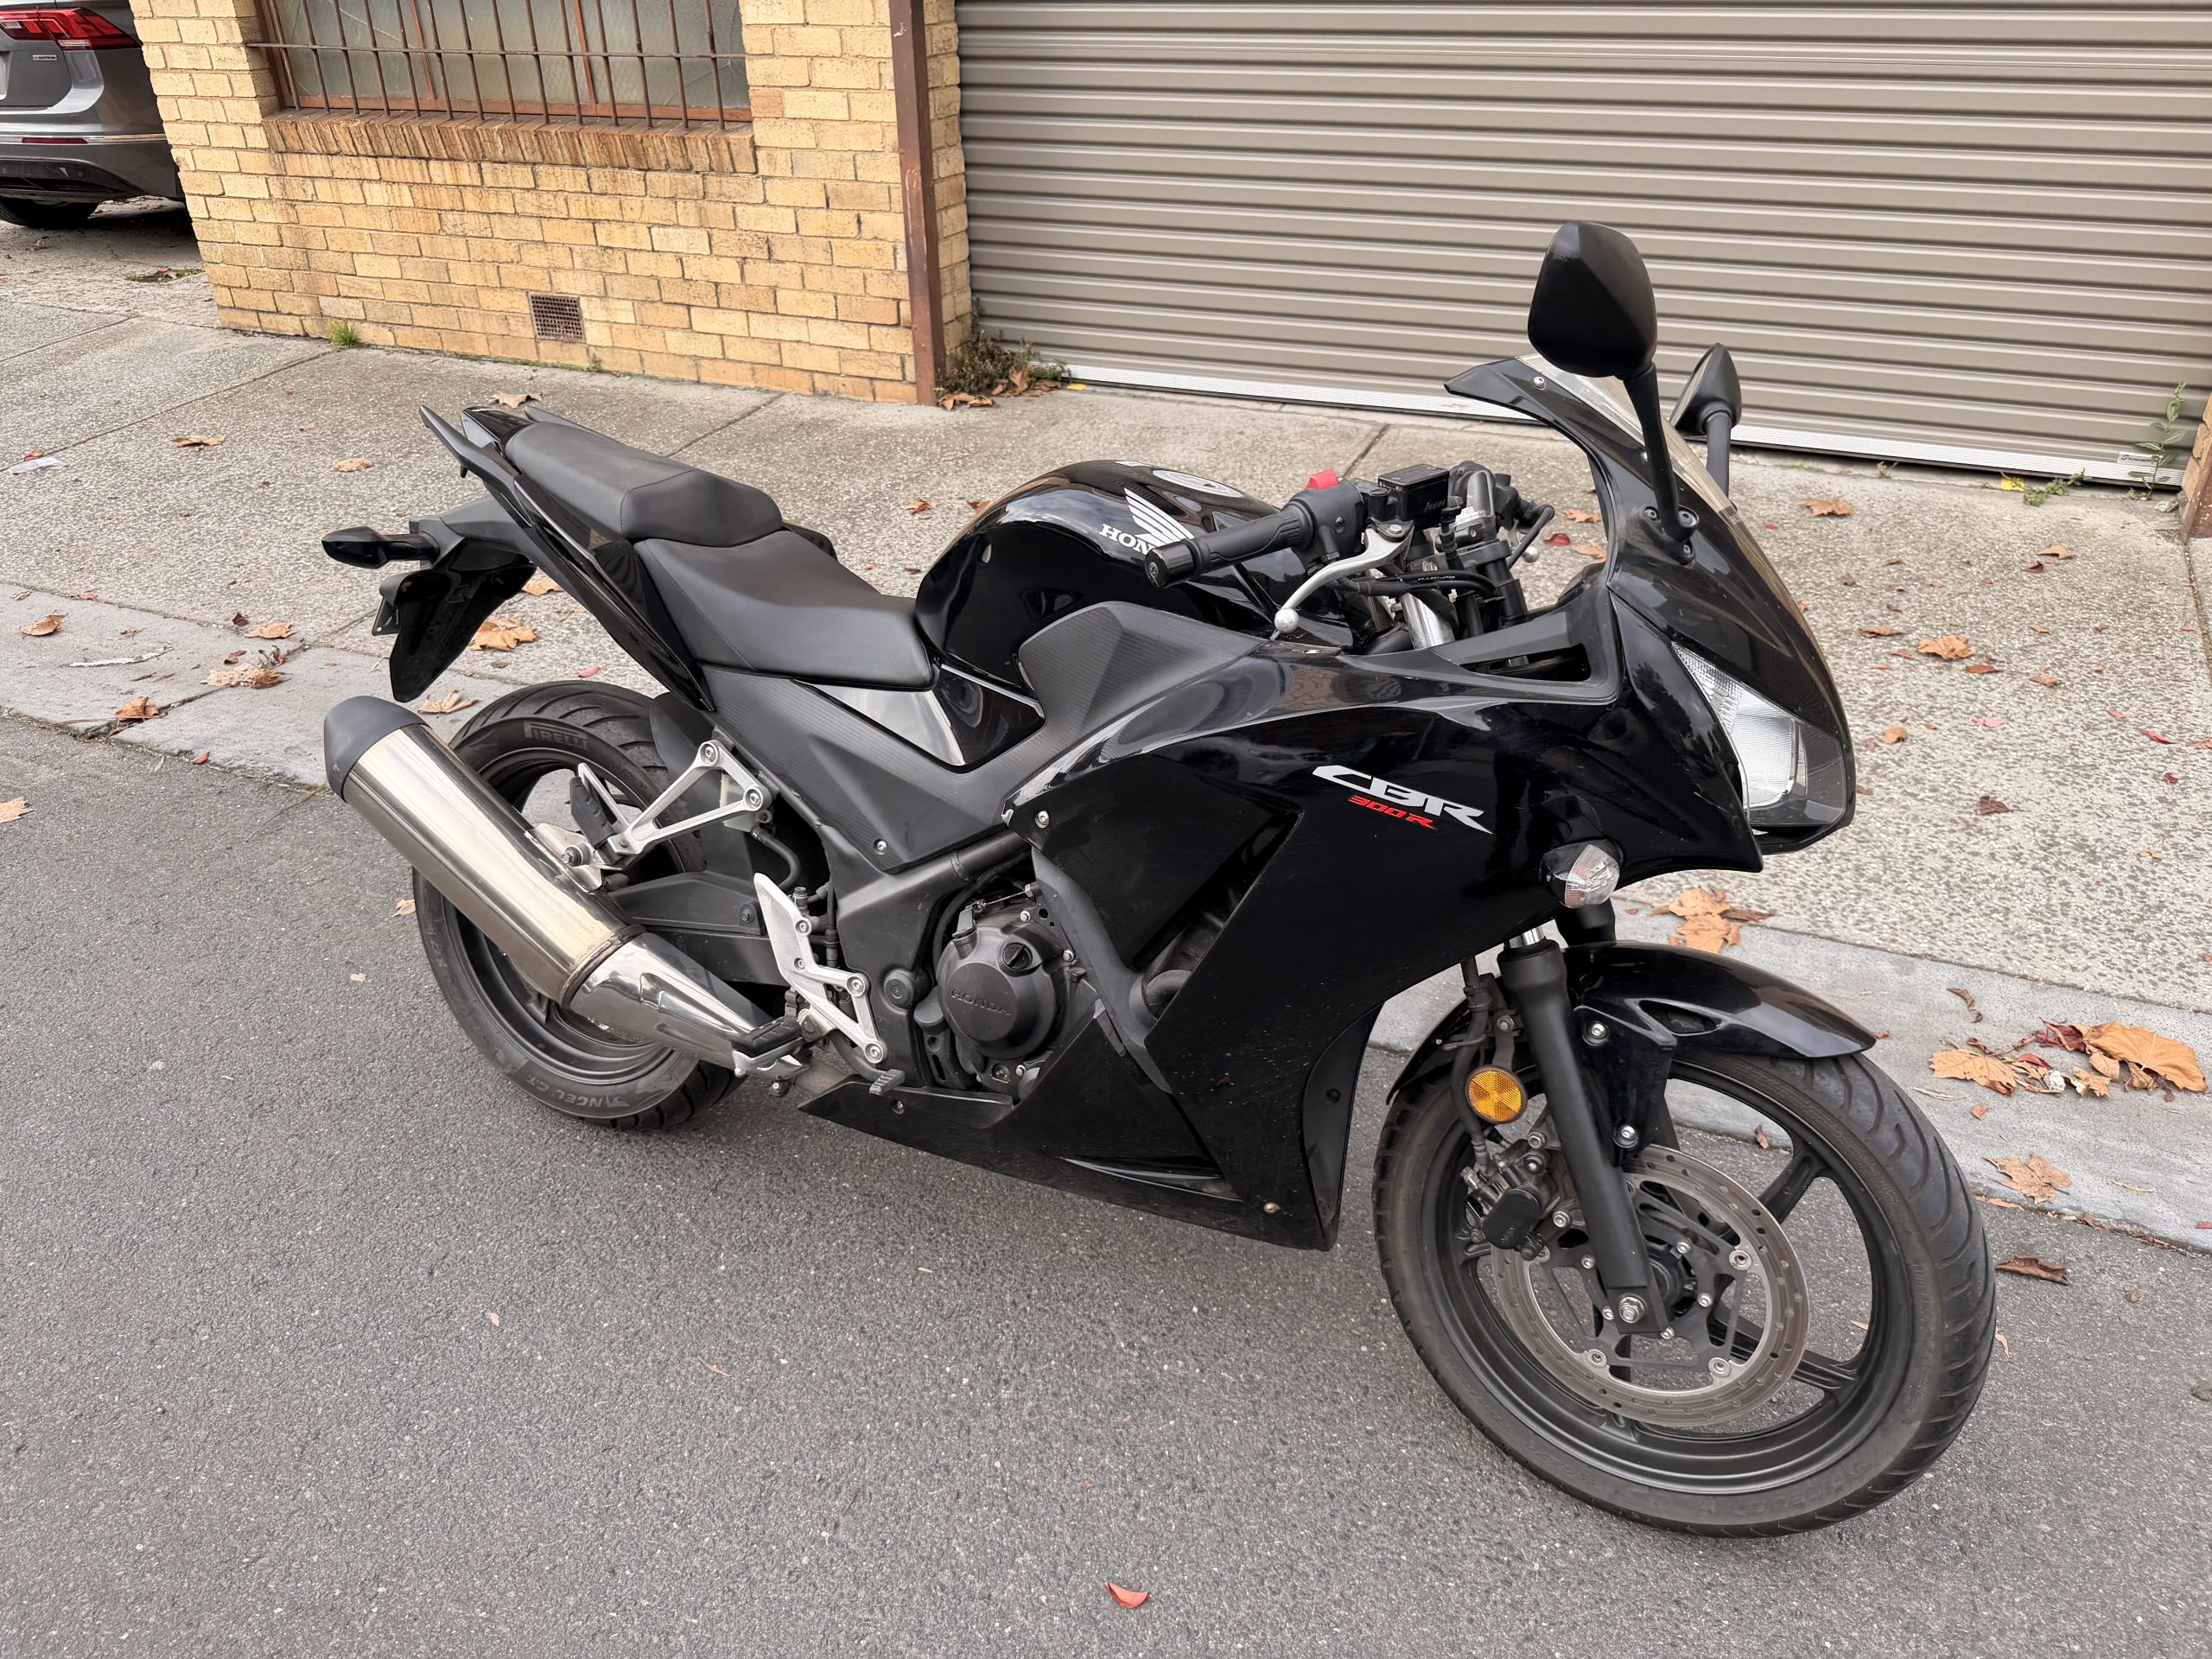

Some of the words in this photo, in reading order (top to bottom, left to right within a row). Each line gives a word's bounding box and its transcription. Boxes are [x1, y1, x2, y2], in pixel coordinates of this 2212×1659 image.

[1098, 524, 1156, 556] HON
[523, 721, 588, 751] PIRELLI
[1313, 765, 1493, 835] CBR
[1348, 795, 1438, 830] 300R
[950, 988, 1012, 1016] HONDA
